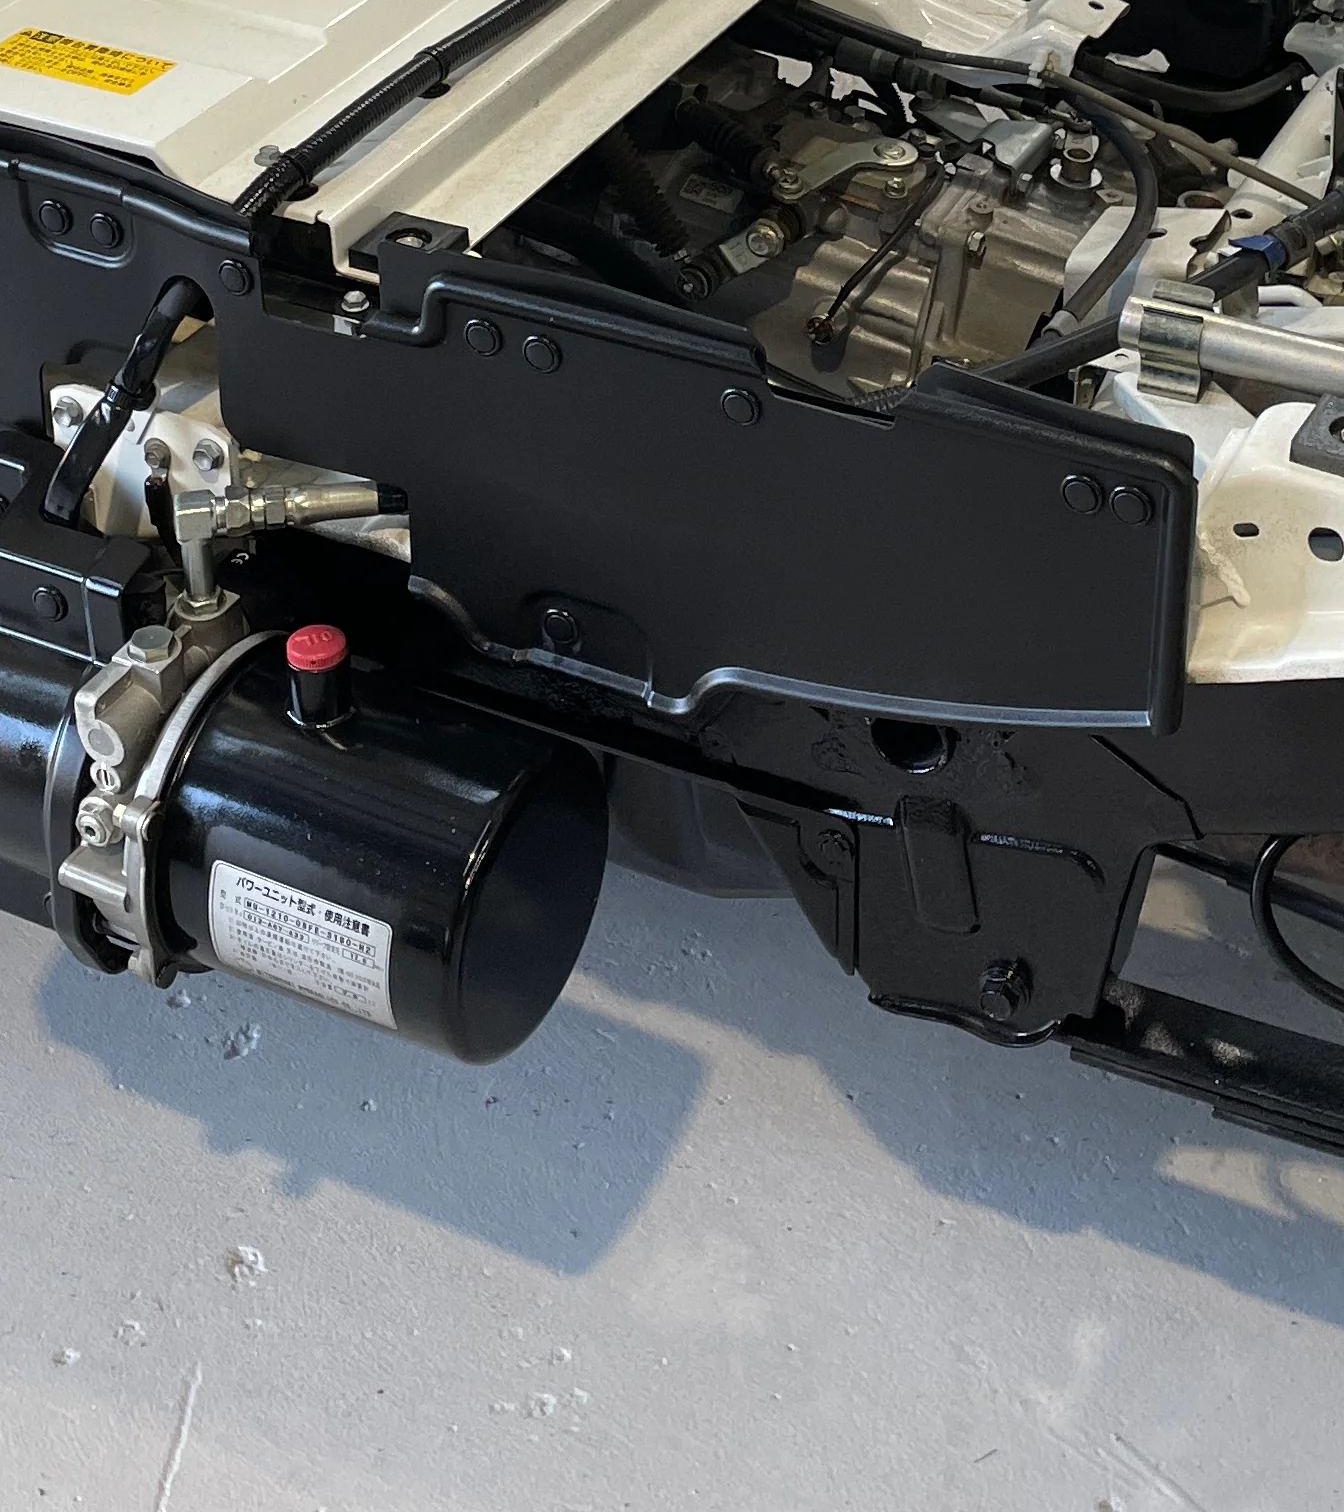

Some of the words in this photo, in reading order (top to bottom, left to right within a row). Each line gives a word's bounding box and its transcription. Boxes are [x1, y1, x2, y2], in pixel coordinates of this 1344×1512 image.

[236, 877, 371, 938] パワーユニット型式・使用注意書
